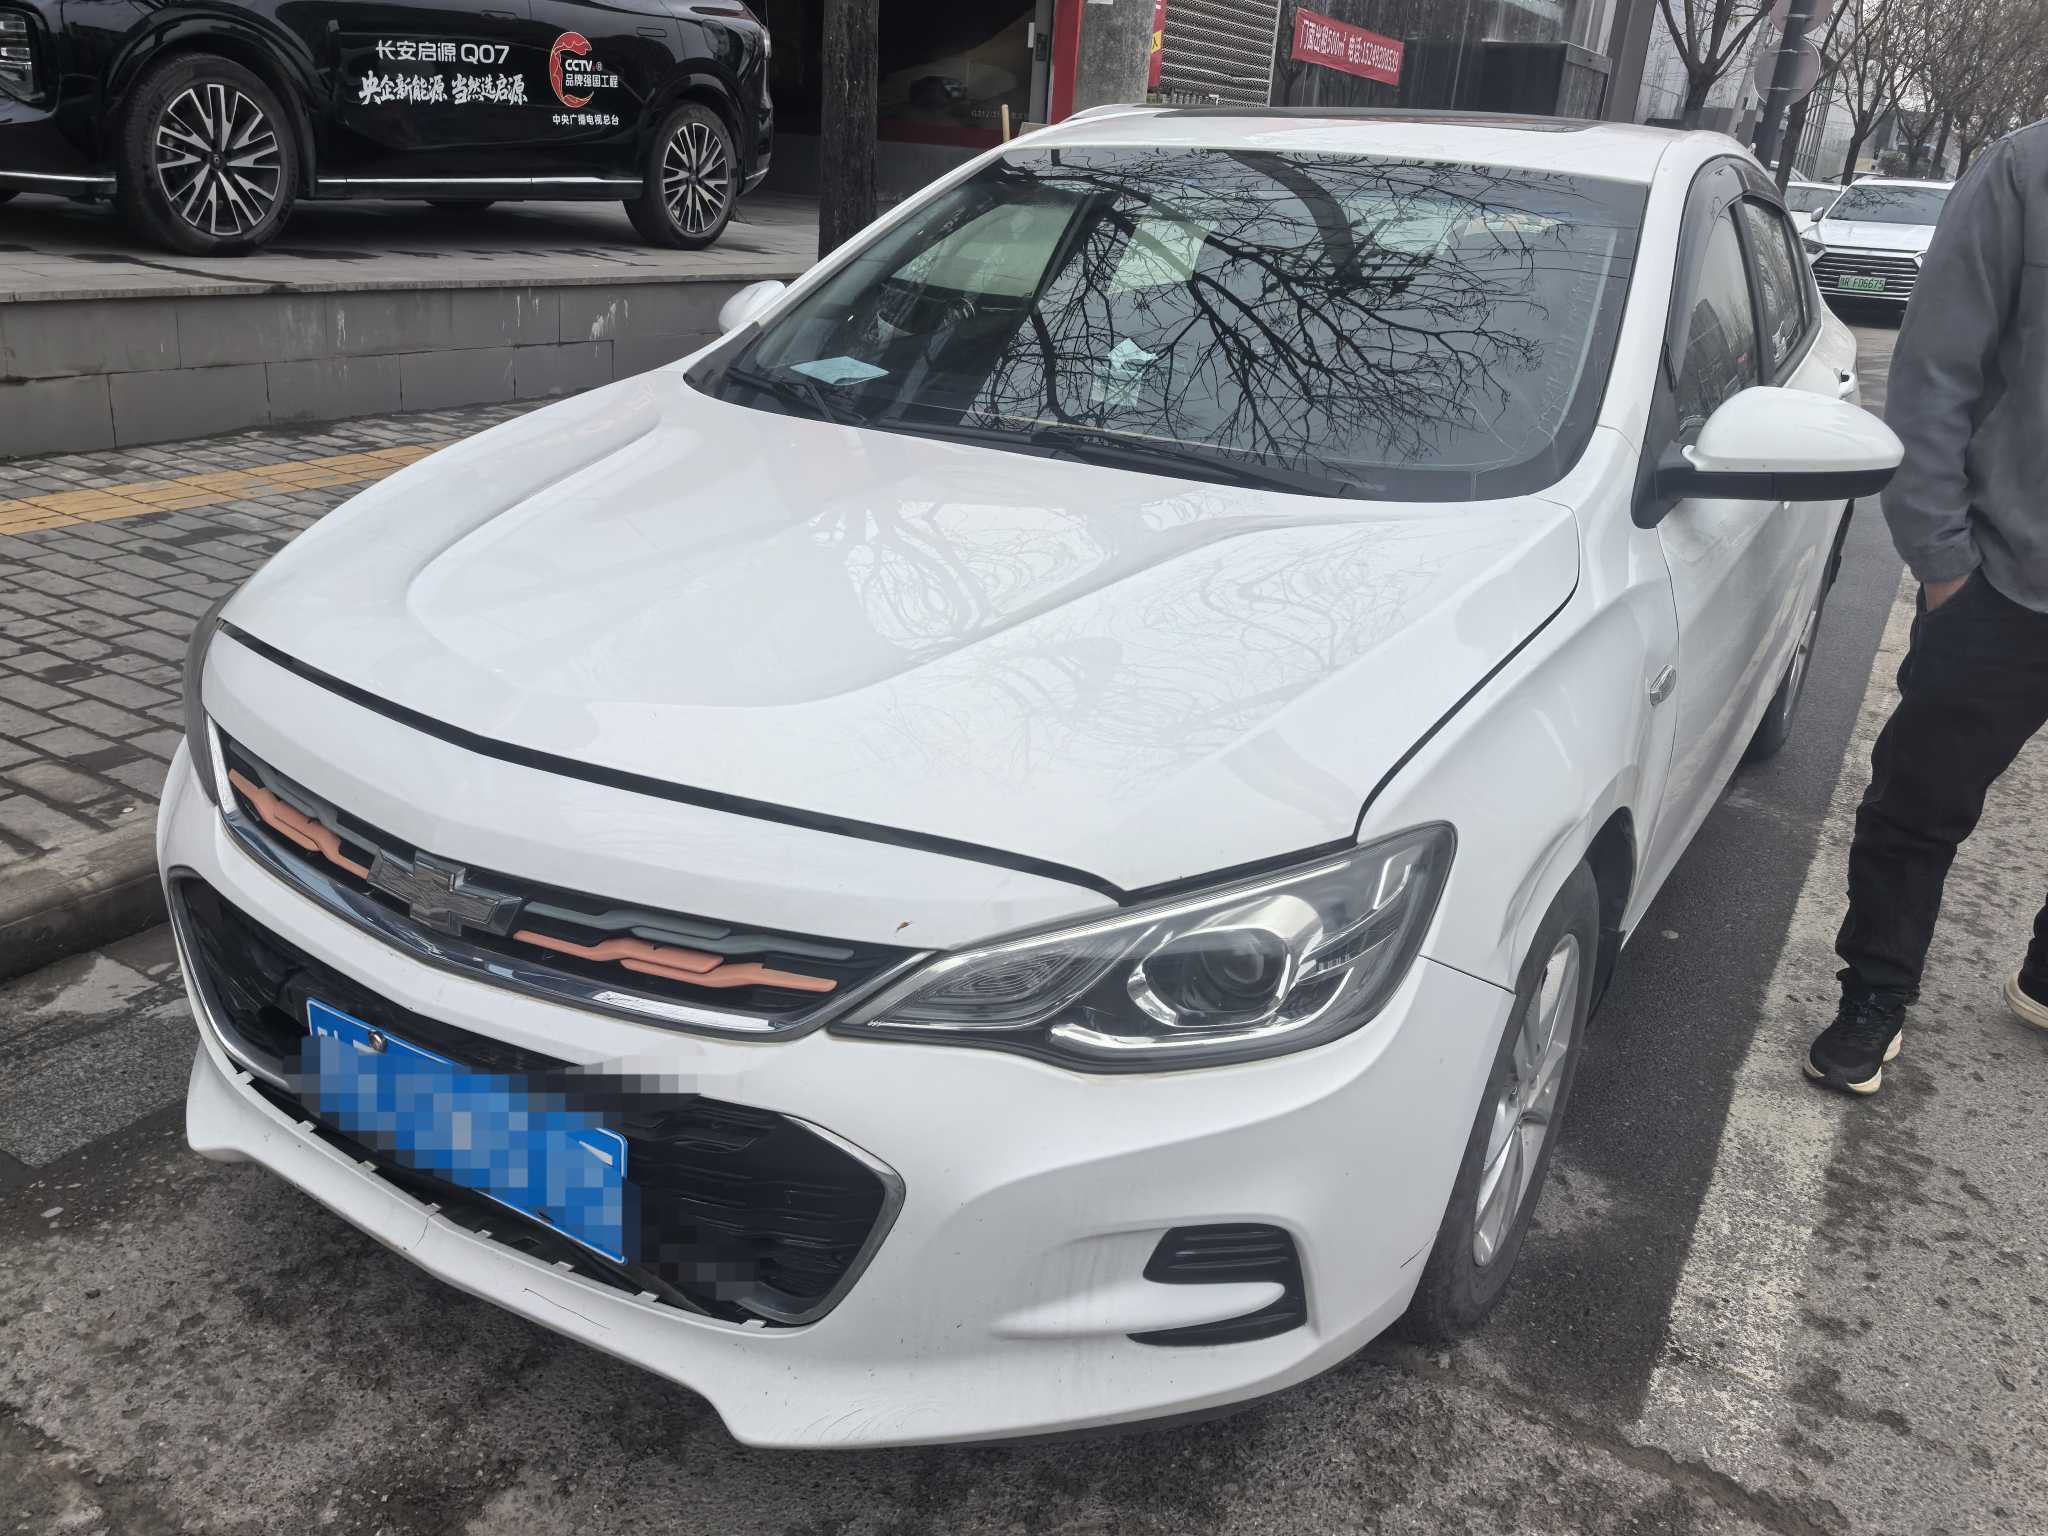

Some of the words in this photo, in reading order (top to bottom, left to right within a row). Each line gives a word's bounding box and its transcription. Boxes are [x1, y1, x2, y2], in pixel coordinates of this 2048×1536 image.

[375, 40, 456, 62] 长安启源
[461, 44, 510, 65] Q07
[358, 70, 448, 105] 央企新能源
[451, 73, 528, 105] 当然选启源
[565, 73, 619, 88] 品牌强国工程
[552, 113, 619, 126] 中央广播电视总台
